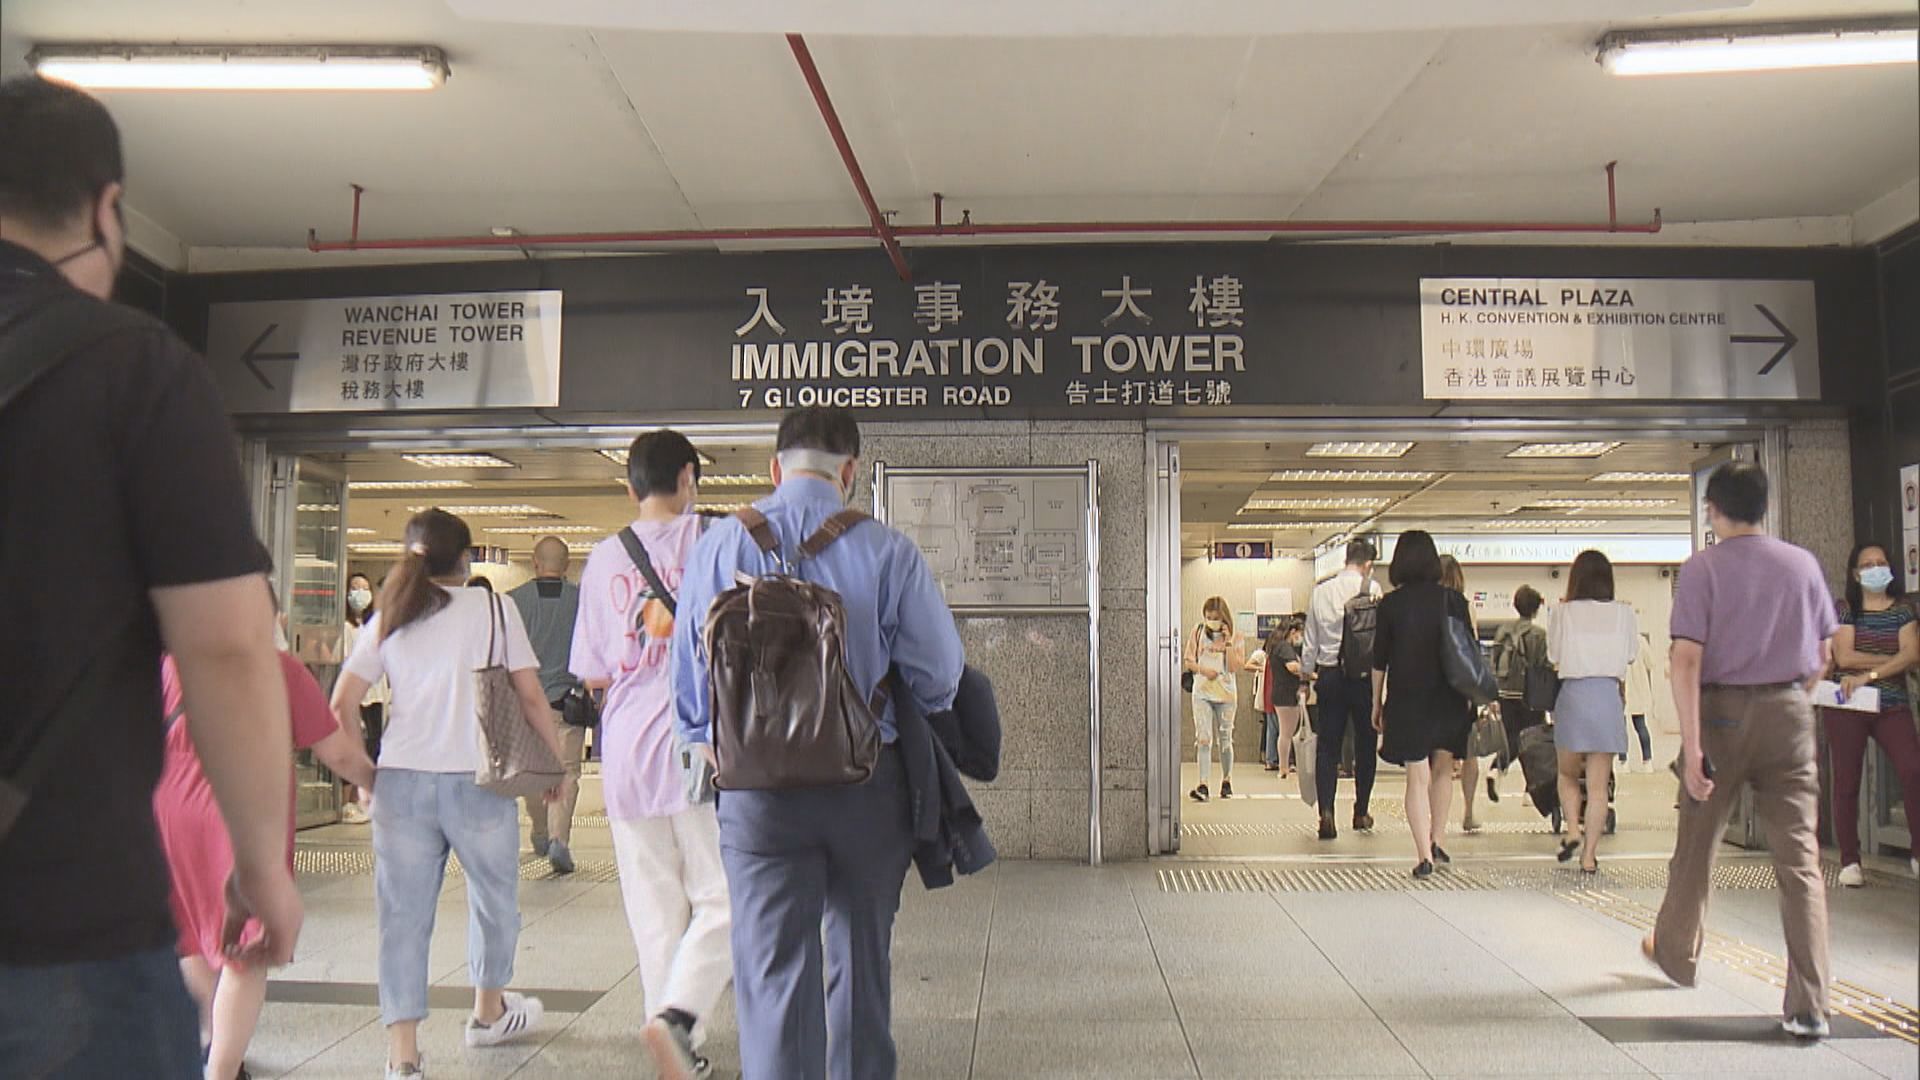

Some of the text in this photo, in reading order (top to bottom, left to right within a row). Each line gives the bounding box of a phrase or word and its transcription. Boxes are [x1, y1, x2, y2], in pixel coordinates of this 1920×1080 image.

[734, 275, 1244, 336] 入境事務大樓
[1441, 288, 1634, 307] CENTRAL PLAZA
[344, 302, 524, 323] WANCHAI TOWER
[1477, 312, 1569, 324] CONVENTION
[1573, 312, 1582, 324] &
[1587, 312, 1665, 325] EXHIBITION
[1669, 313, 1726, 325] CENTRE
[342, 325, 523, 346] REVENUE TOWER
[731, 334, 1246, 381] IMMIGRATION TOWER
[1442, 337, 1534, 360] 中環廣場
[342, 351, 469, 373] 灣仔政府大樓
[1444, 365, 1636, 388] 香港會議展覽中心
[739, 386, 1011, 408] 7 GLOUCESTER ROAD
[1065, 379, 1232, 406] 告士打道七號
